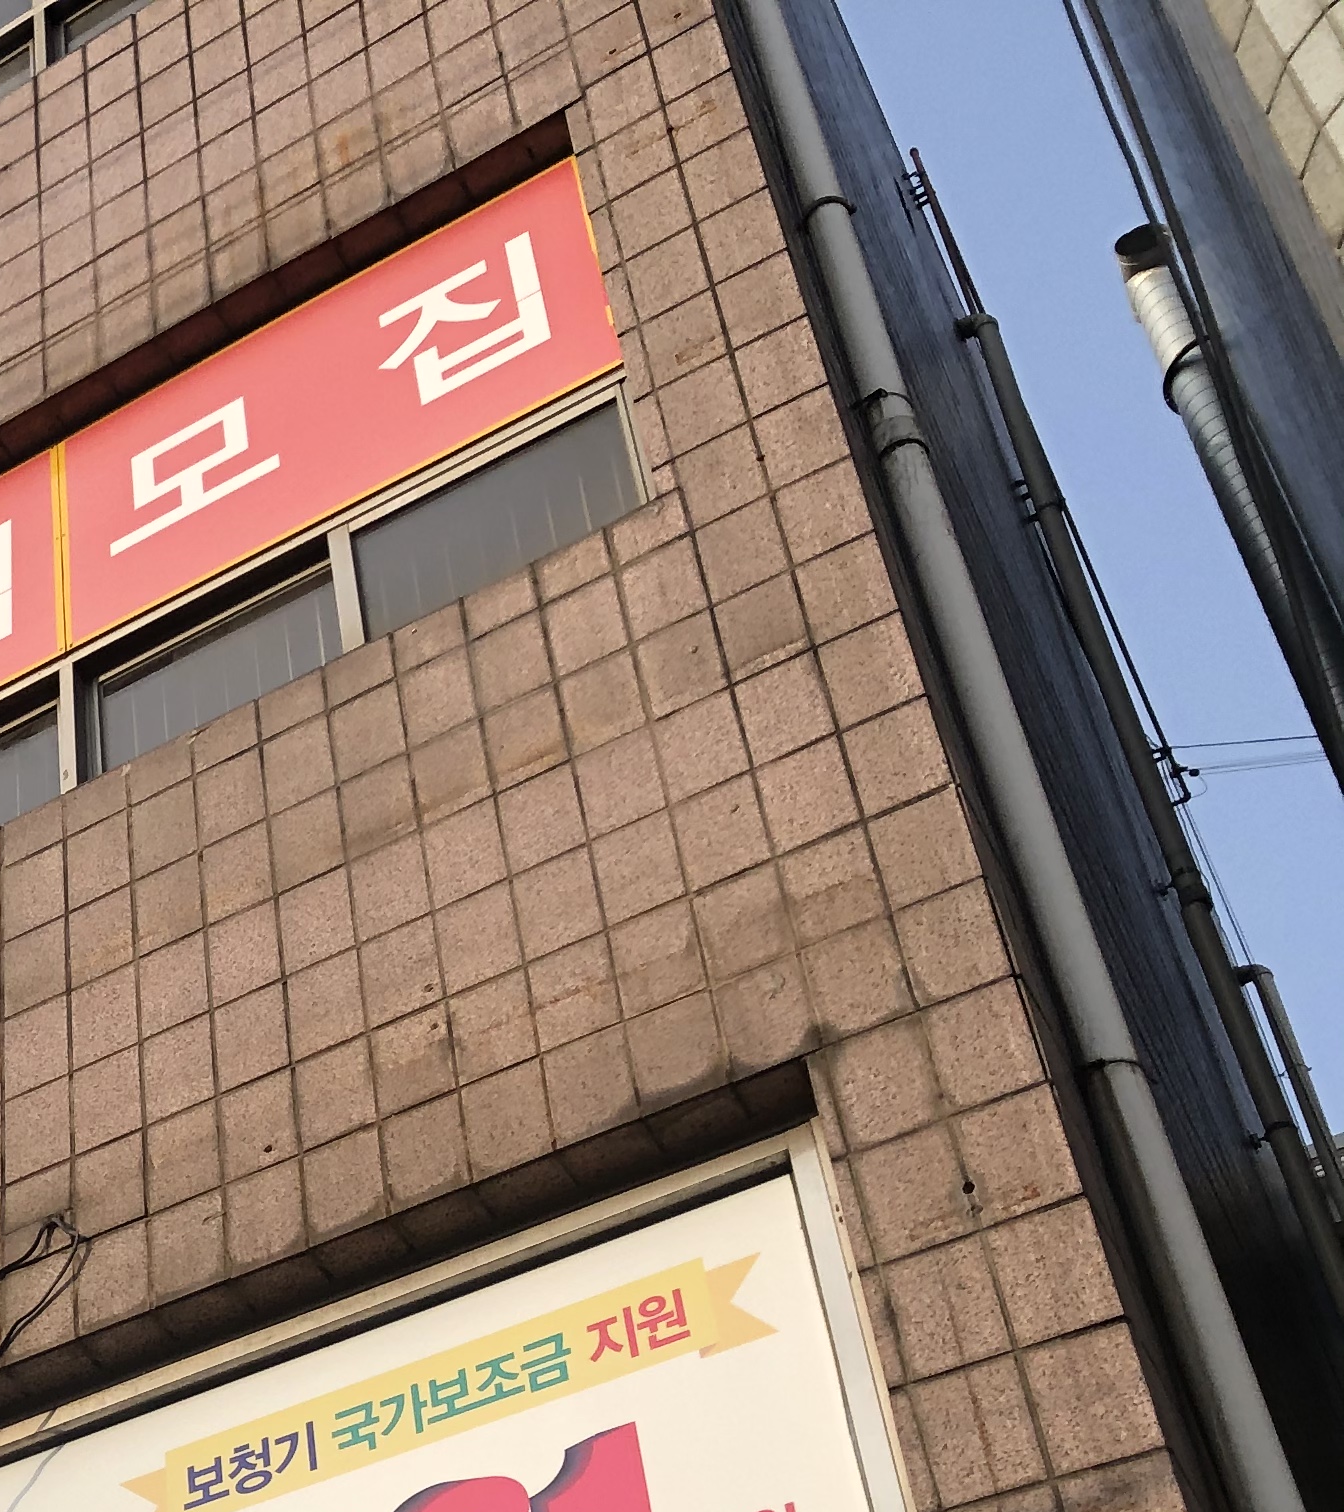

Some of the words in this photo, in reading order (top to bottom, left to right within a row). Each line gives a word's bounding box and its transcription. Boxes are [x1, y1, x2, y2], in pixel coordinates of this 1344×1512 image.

[182, 1421, 318, 1511] 보청기
[331, 1331, 572, 1452] 국가보조금
[586, 1287, 692, 1364] 지원
